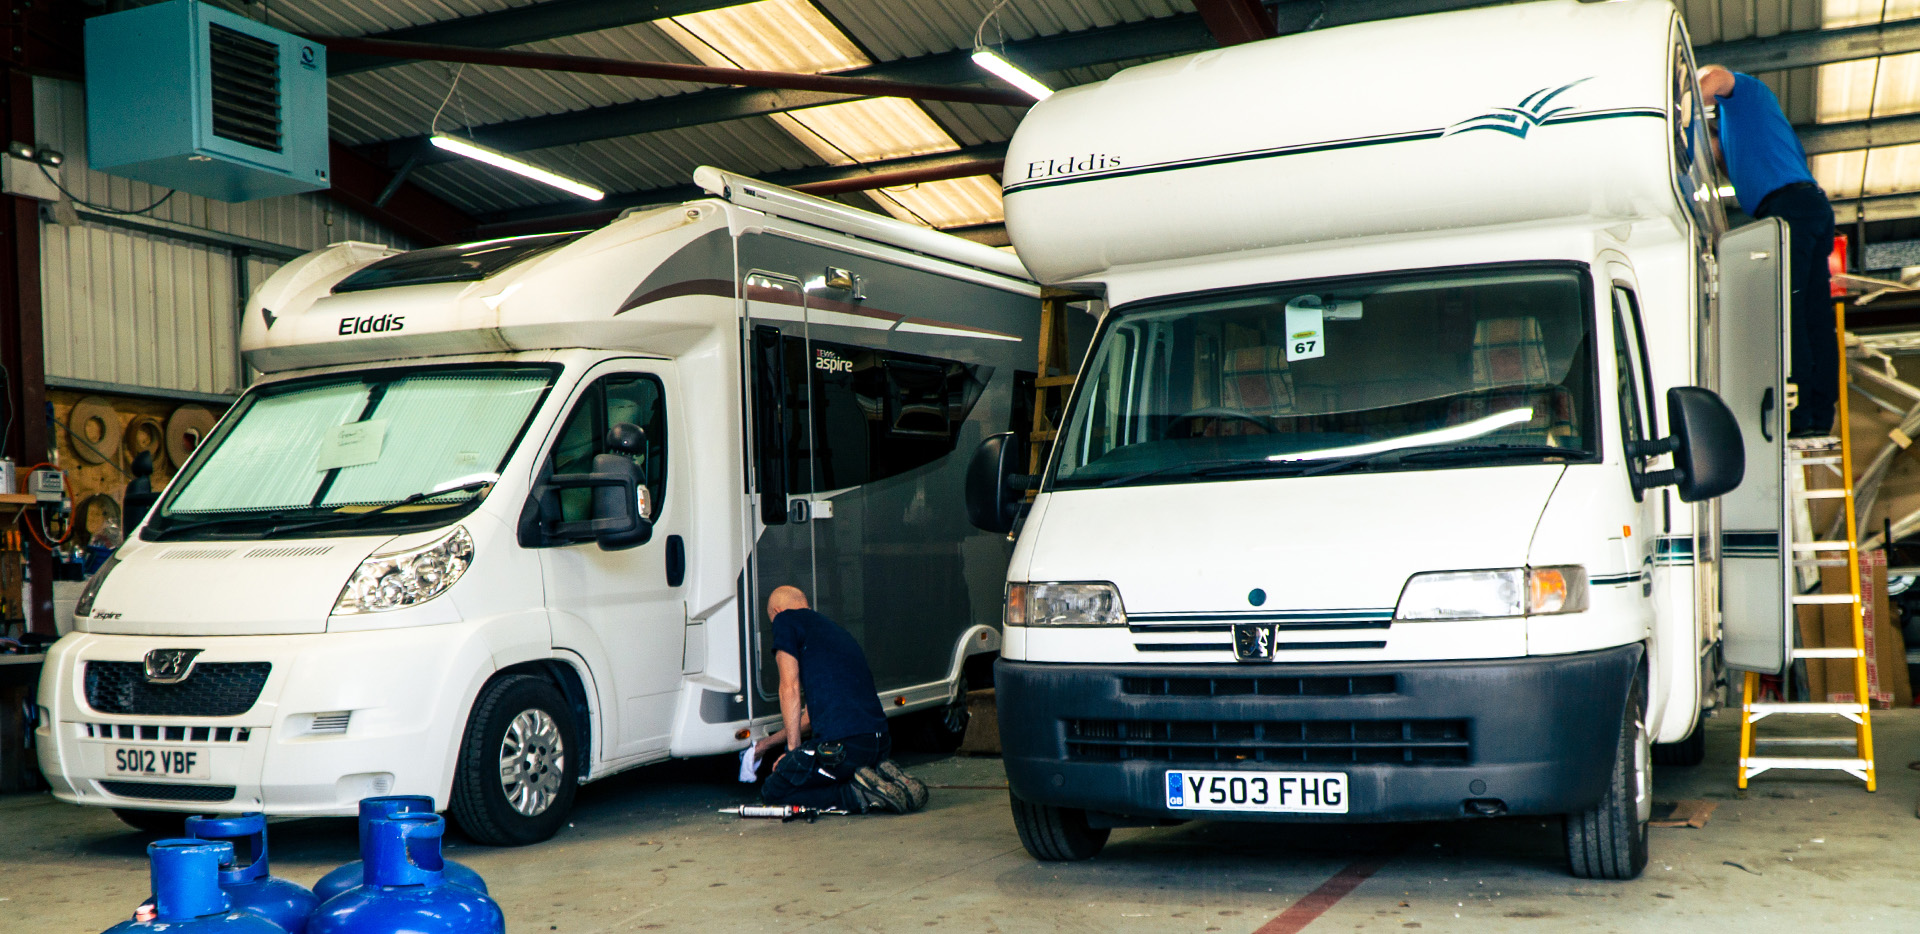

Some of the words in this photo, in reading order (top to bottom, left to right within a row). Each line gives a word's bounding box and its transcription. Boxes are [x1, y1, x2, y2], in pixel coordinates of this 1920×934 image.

[1026, 153, 1121, 180] Elddis
[338, 313, 406, 336] Elddis
[1295, 340, 1316, 354] 67
[815, 356, 853, 374] aspire
[160, 750, 197, 775] VBF
[1169, 796, 1183, 805] GB
[1188, 776, 1269, 805] Y503
[1279, 777, 1342, 807] FHG
